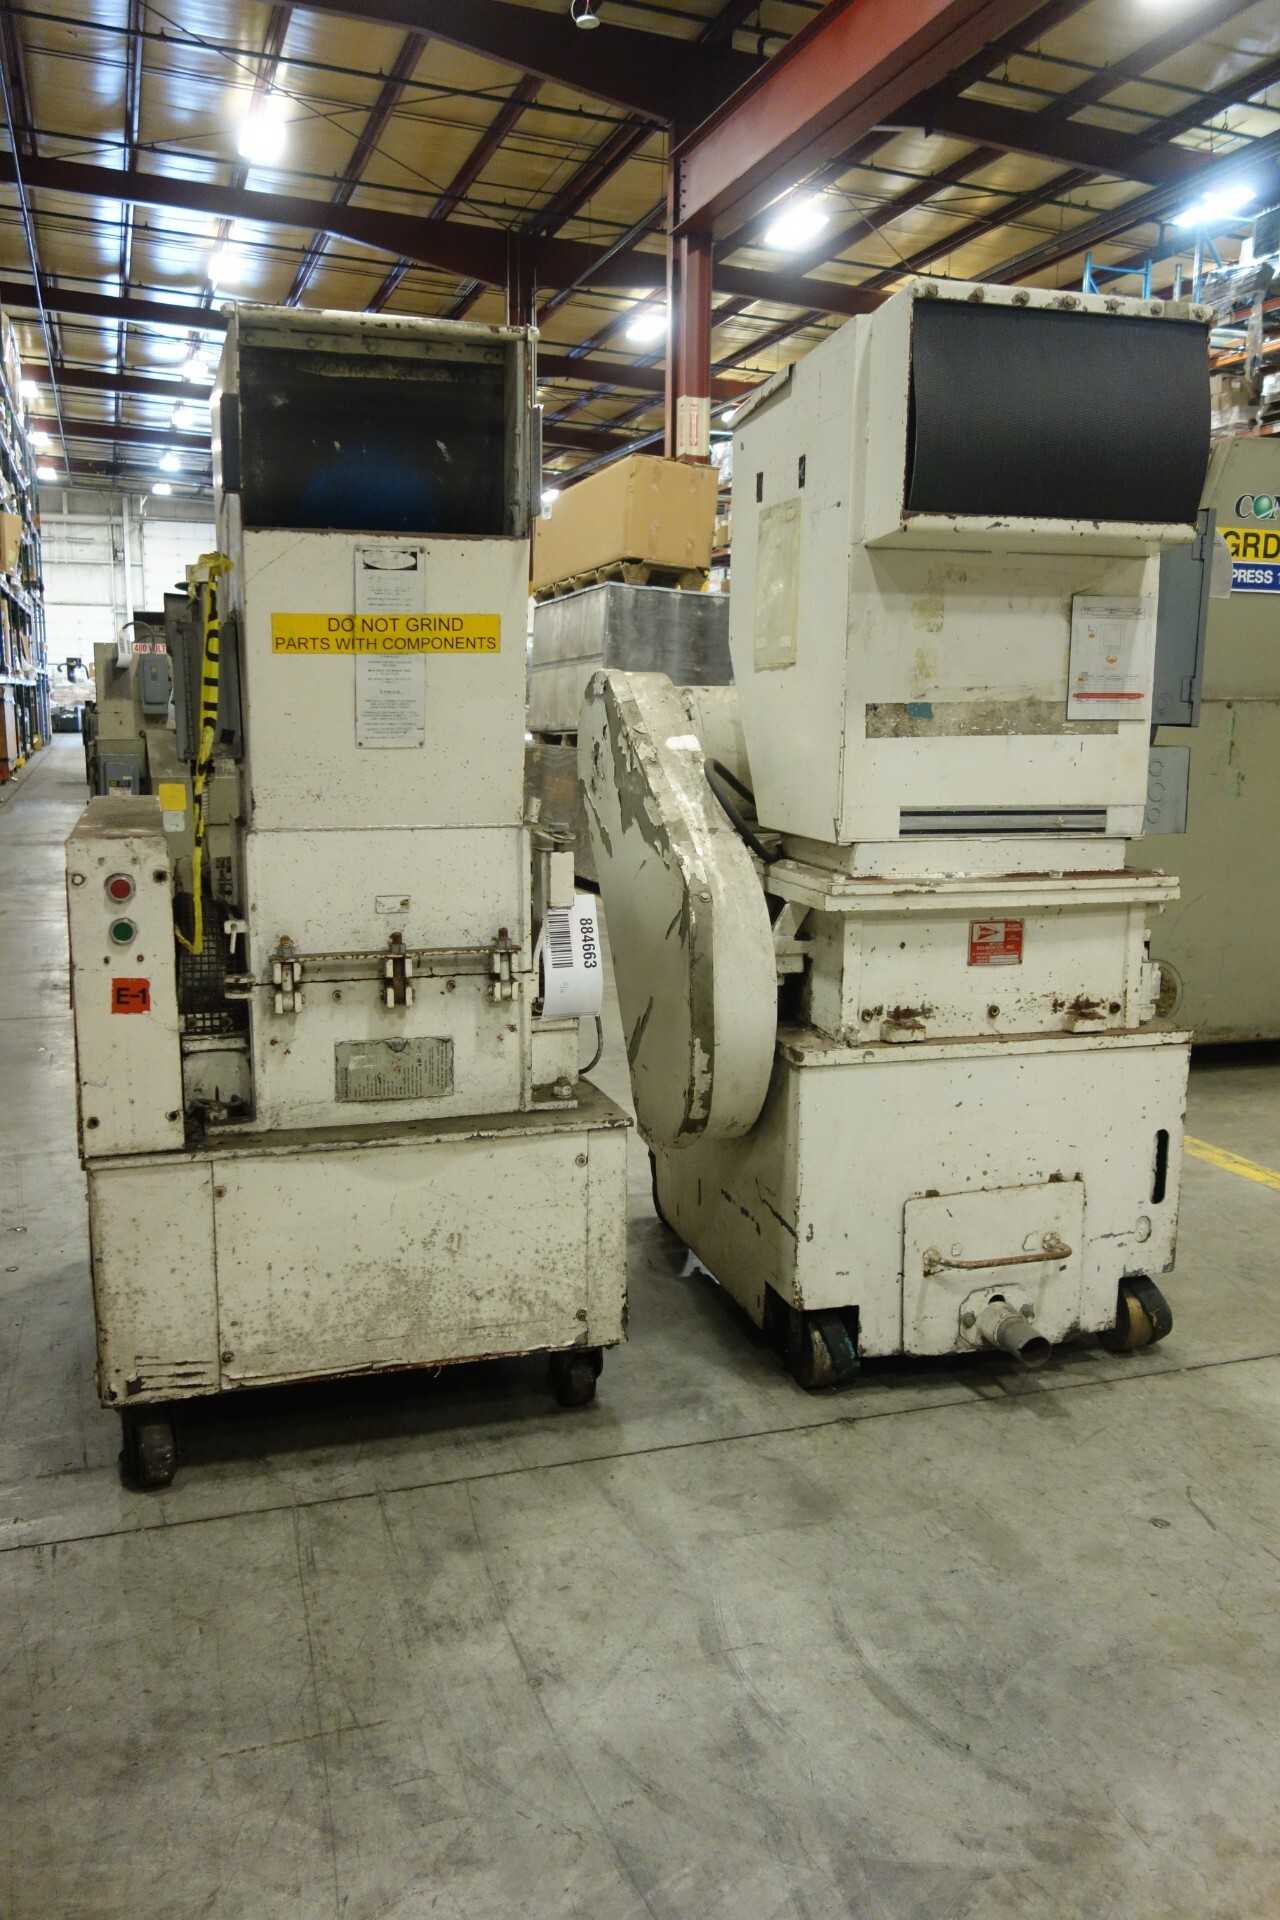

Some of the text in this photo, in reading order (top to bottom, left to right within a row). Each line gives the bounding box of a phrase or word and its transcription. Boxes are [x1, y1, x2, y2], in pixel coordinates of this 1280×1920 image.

[327, 617, 464, 632] DO NOT GRIND
[275, 637, 497, 650] PARTS WITH COMPONENTS
[579, 917, 598, 969] 884663
[116, 987, 147, 1005] E-1
